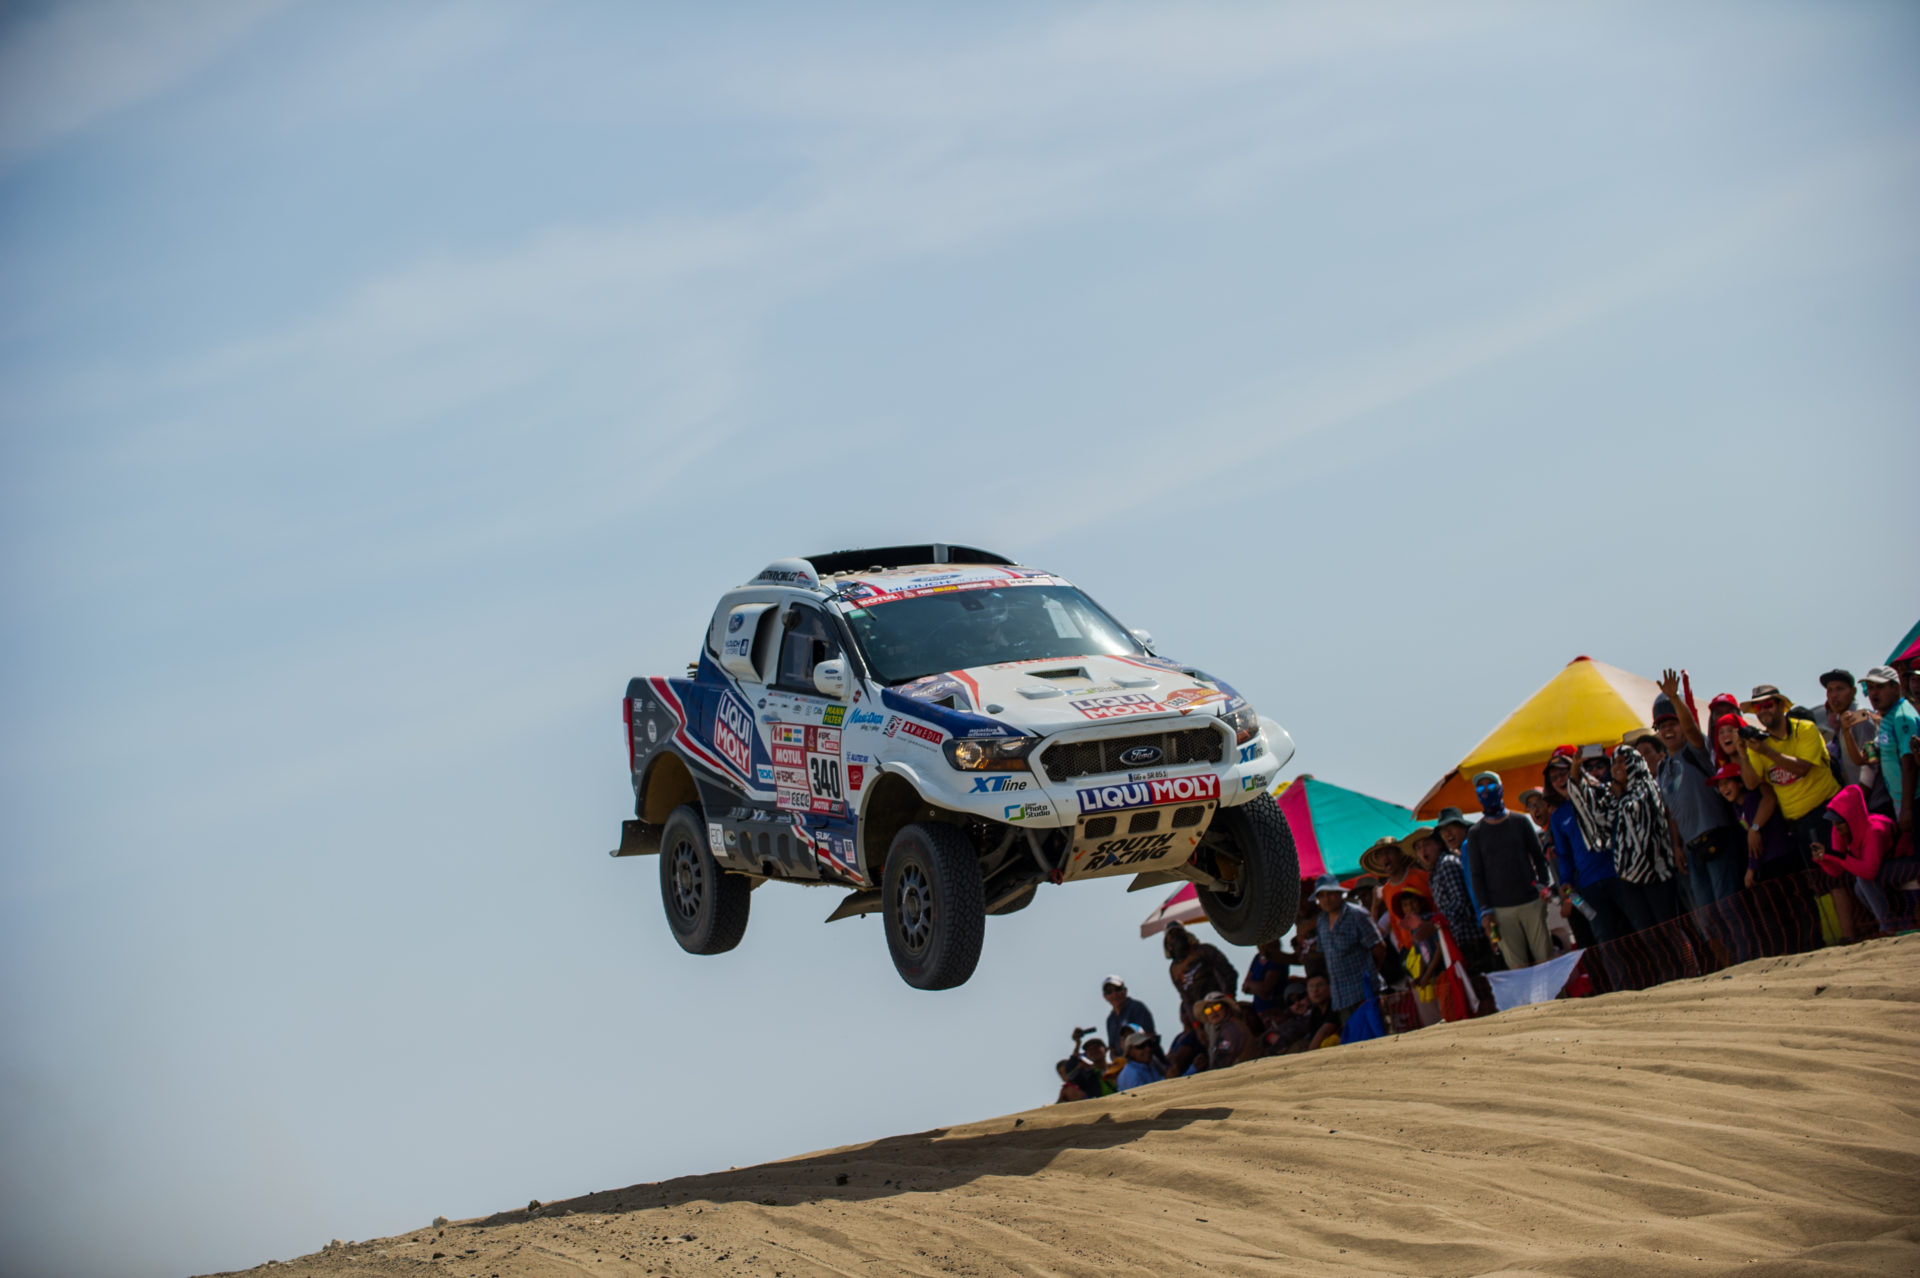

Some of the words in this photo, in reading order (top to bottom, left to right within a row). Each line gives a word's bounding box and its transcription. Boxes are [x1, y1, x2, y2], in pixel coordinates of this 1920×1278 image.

[1077, 694, 1149, 710] LIQUI
[1089, 703, 1161, 719] MOLY
[719, 695, 750, 745] LIQUI
[717, 720, 749, 770] MOLY
[1130, 748, 1154, 760] Ford
[775, 748, 802, 765] MOTUL
[811, 757, 841, 799] 340
[968, 775, 1028, 793] XTline
[1080, 783, 1150, 809] LIQUI
[1151, 774, 1217, 801] MOLY
[1089, 832, 1177, 856] SOUTH
